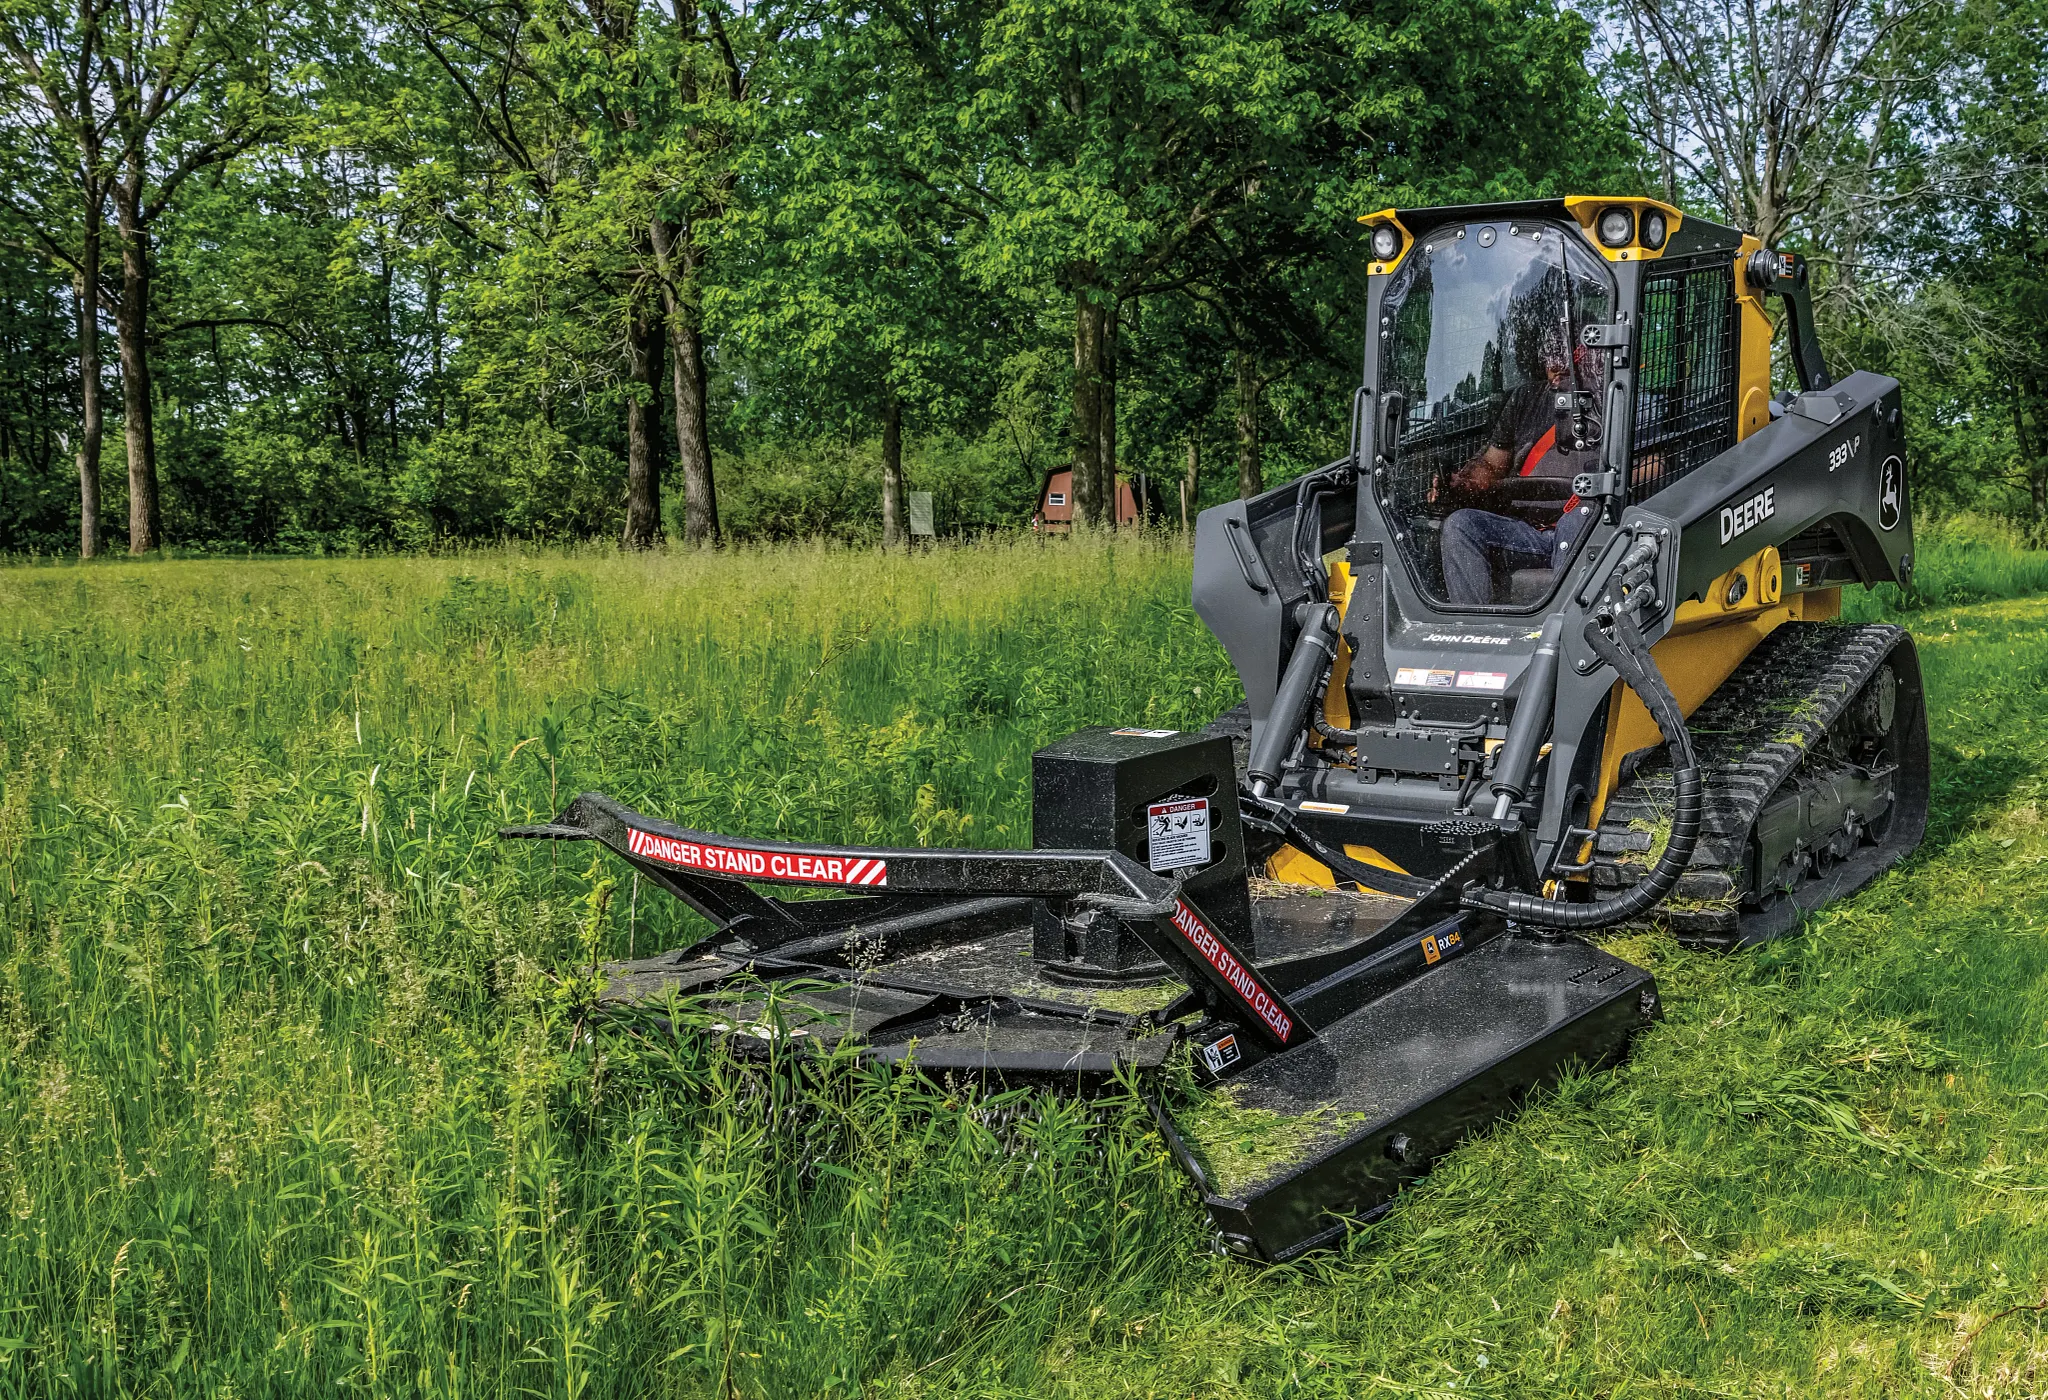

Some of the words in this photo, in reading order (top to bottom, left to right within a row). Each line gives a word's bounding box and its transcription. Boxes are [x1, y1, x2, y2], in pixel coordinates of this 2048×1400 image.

[1720, 487, 1775, 545] DEERE
[1422, 633, 1461, 643] JOHN
[1462, 635, 1511, 645] DEERE
[1169, 803, 1196, 813] DANGER
[645, 837, 701, 865] DANGER
[705, 848, 766, 874] STAND
[770, 856, 843, 880] CLEAR
[1438, 931, 1461, 951] RX84
[1217, 952, 1256, 999] STAND
[1255, 993, 1290, 1039] CLEAR
